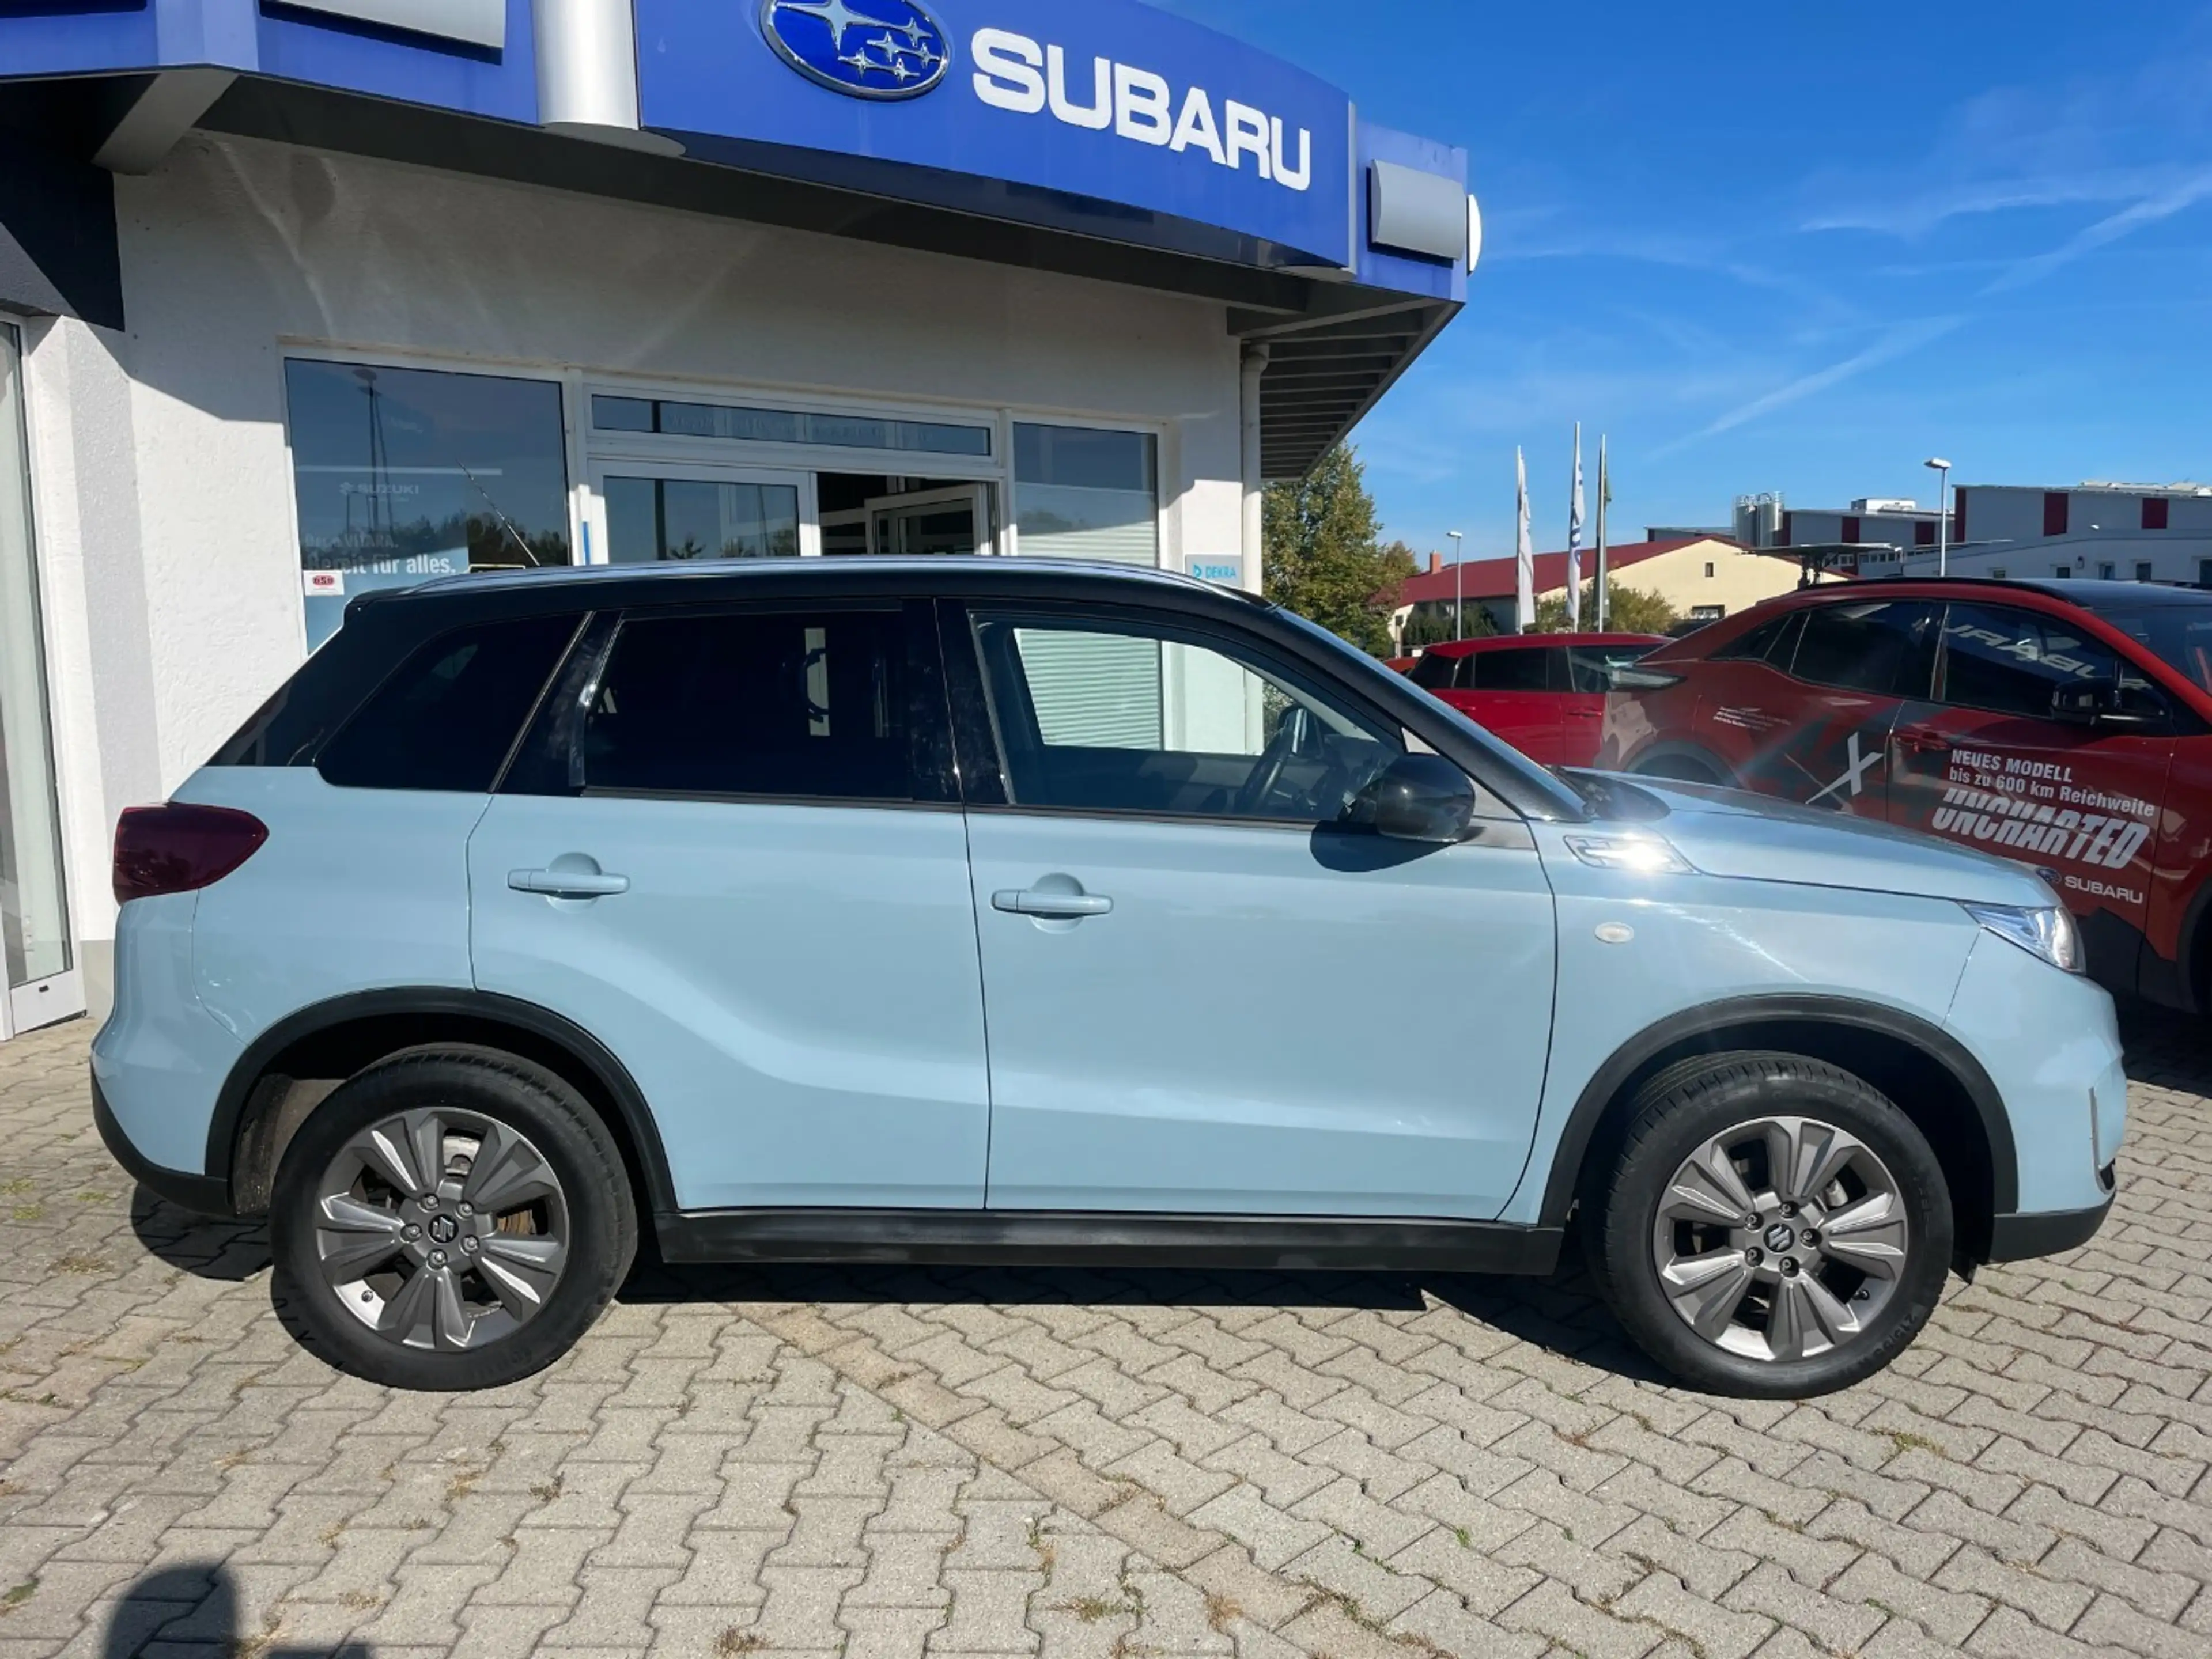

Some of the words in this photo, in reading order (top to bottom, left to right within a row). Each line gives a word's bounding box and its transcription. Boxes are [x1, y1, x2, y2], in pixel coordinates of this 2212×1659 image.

[971, 26, 1310, 191] SUBARU
[406, 554, 457, 574] alles.
[1205, 566, 1237, 578] DEKRA
[1952, 749, 2001, 771] NEUES
[2005, 758, 2073, 783] MODELL
[1949, 767, 1971, 784] bis
[1974, 774, 1991, 787] zu
[1996, 775, 2025, 794] 600
[2030, 781, 2055, 799] km
[2059, 786, 2156, 817] Reichweite
[1931, 787, 2150, 870] UNCHARTED
[2064, 875, 2143, 904] SUBARU
